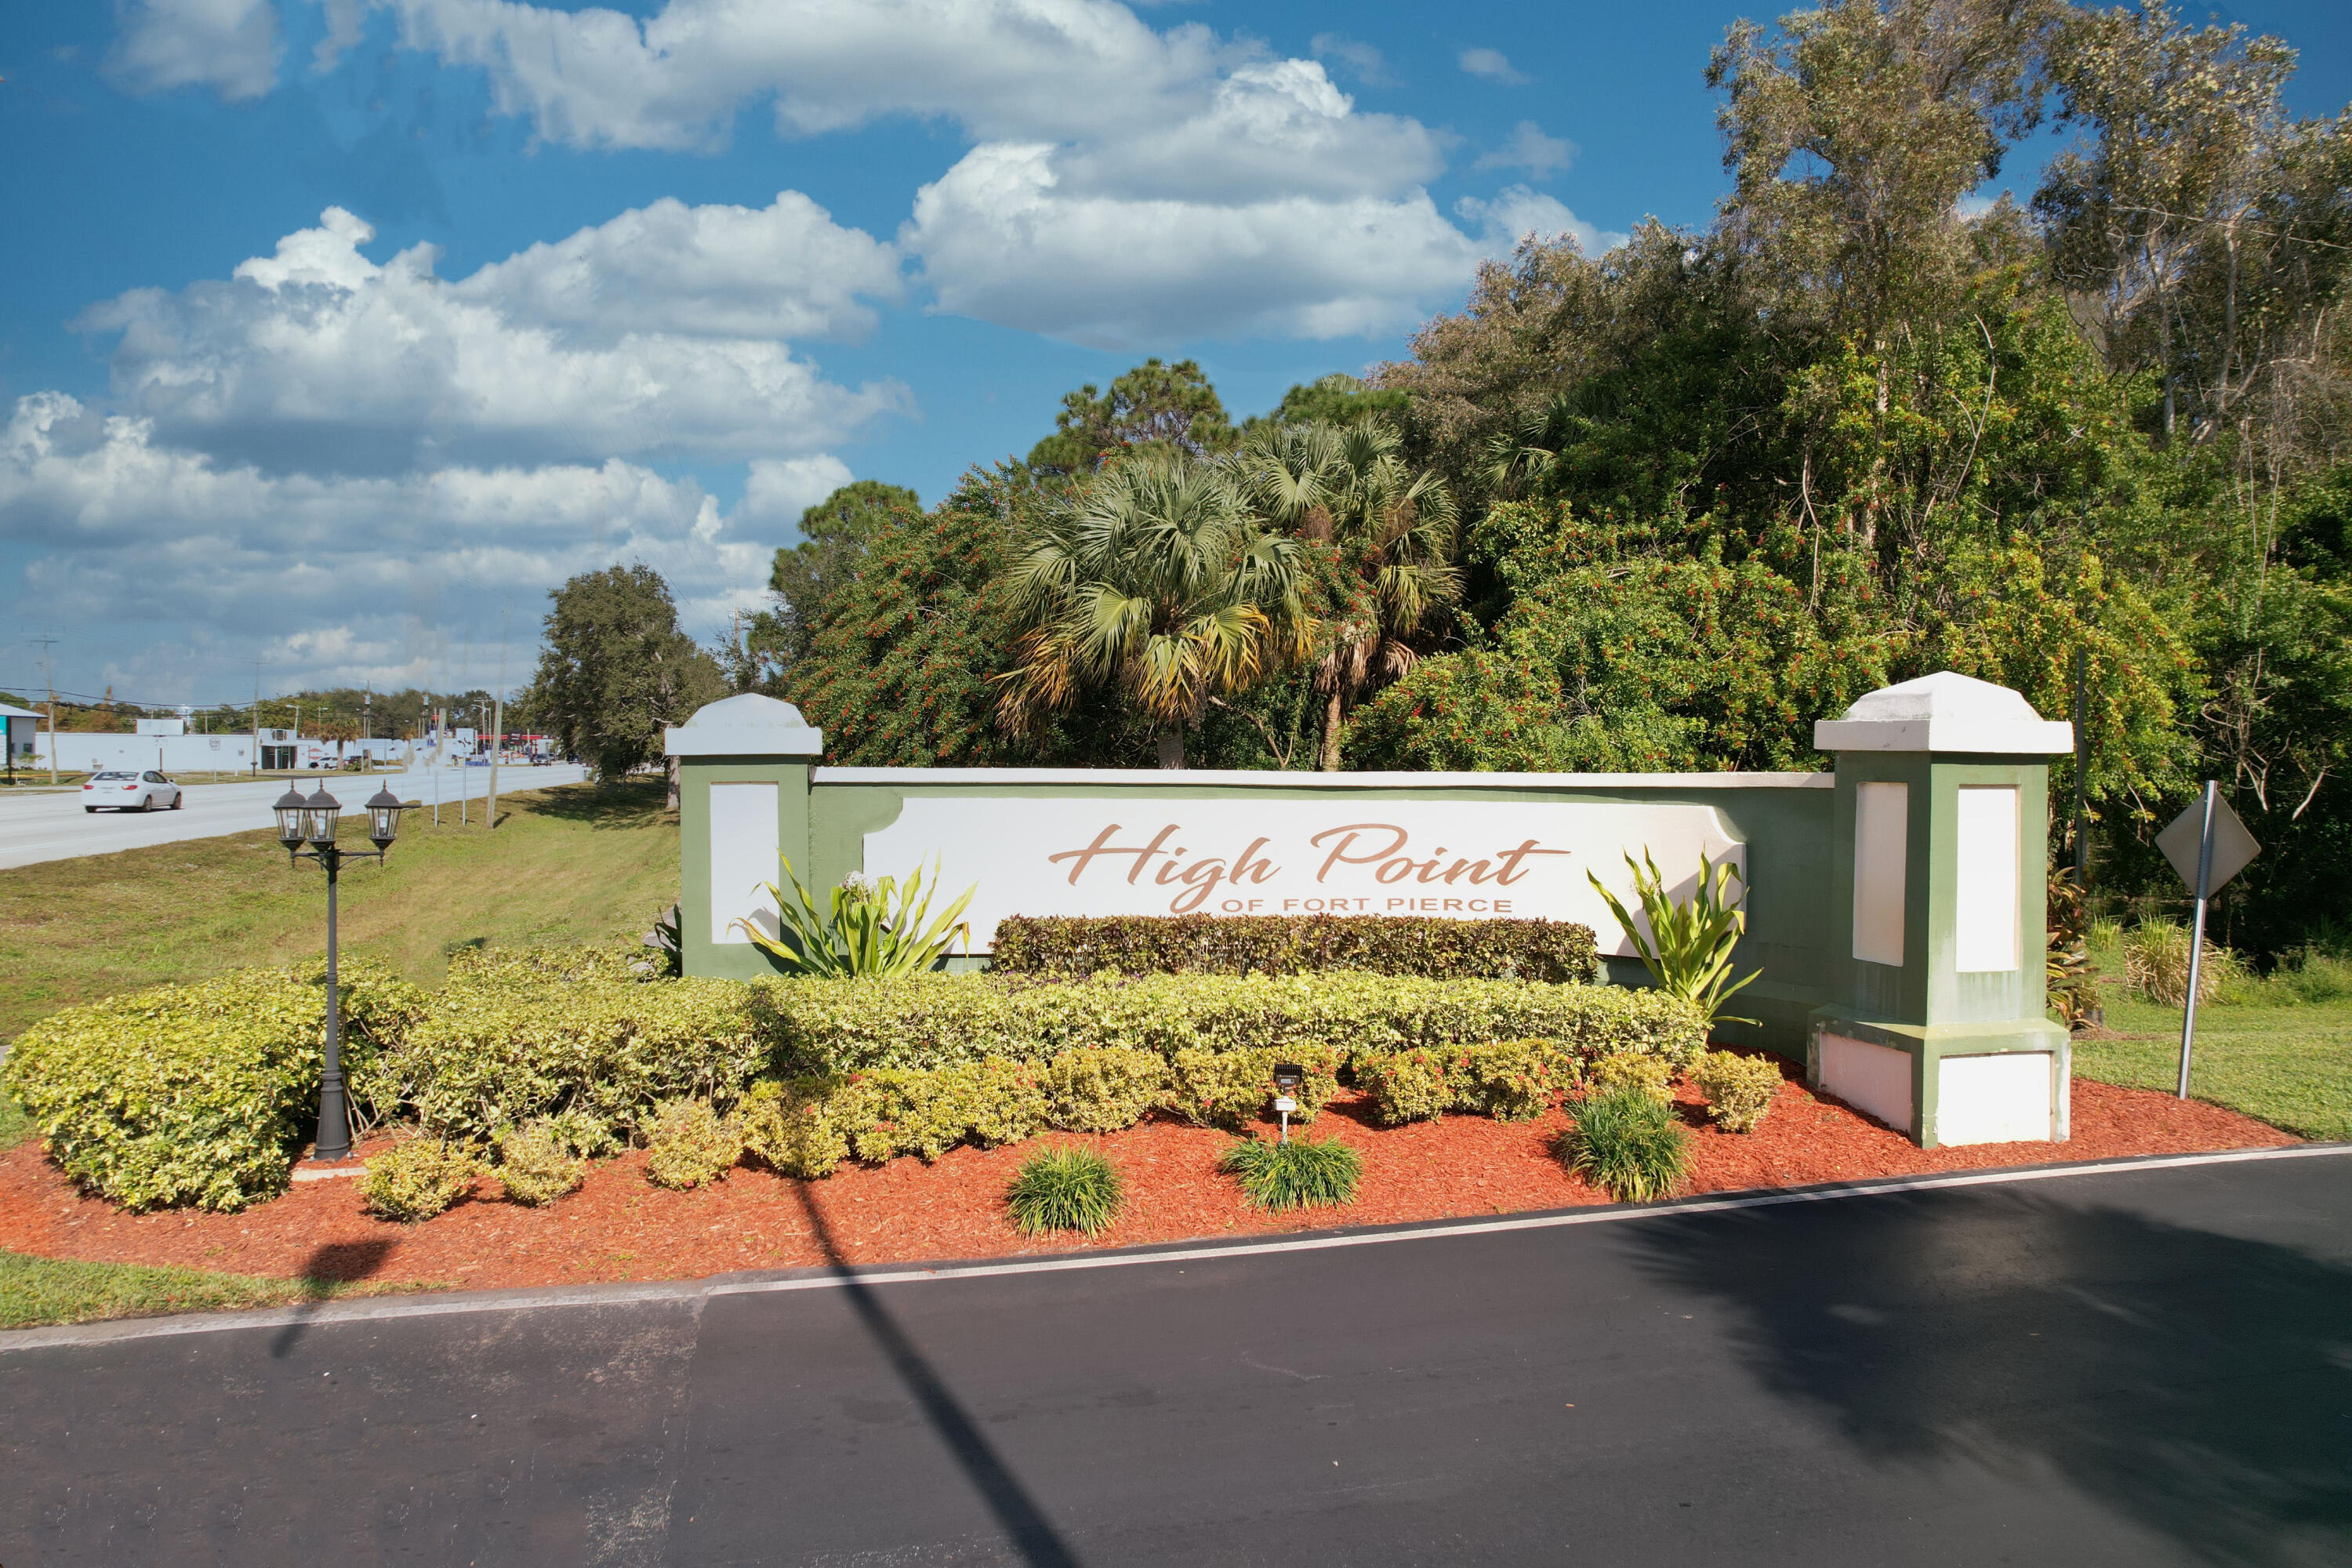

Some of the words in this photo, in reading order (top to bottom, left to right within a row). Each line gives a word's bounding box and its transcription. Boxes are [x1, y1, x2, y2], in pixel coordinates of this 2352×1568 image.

[1048, 823, 1280, 914] High
[1310, 822, 1571, 887] Point
[1221, 898, 1264, 913] OF
[1283, 898, 1374, 911] FORT
[1387, 898, 1512, 913] PIERCE
